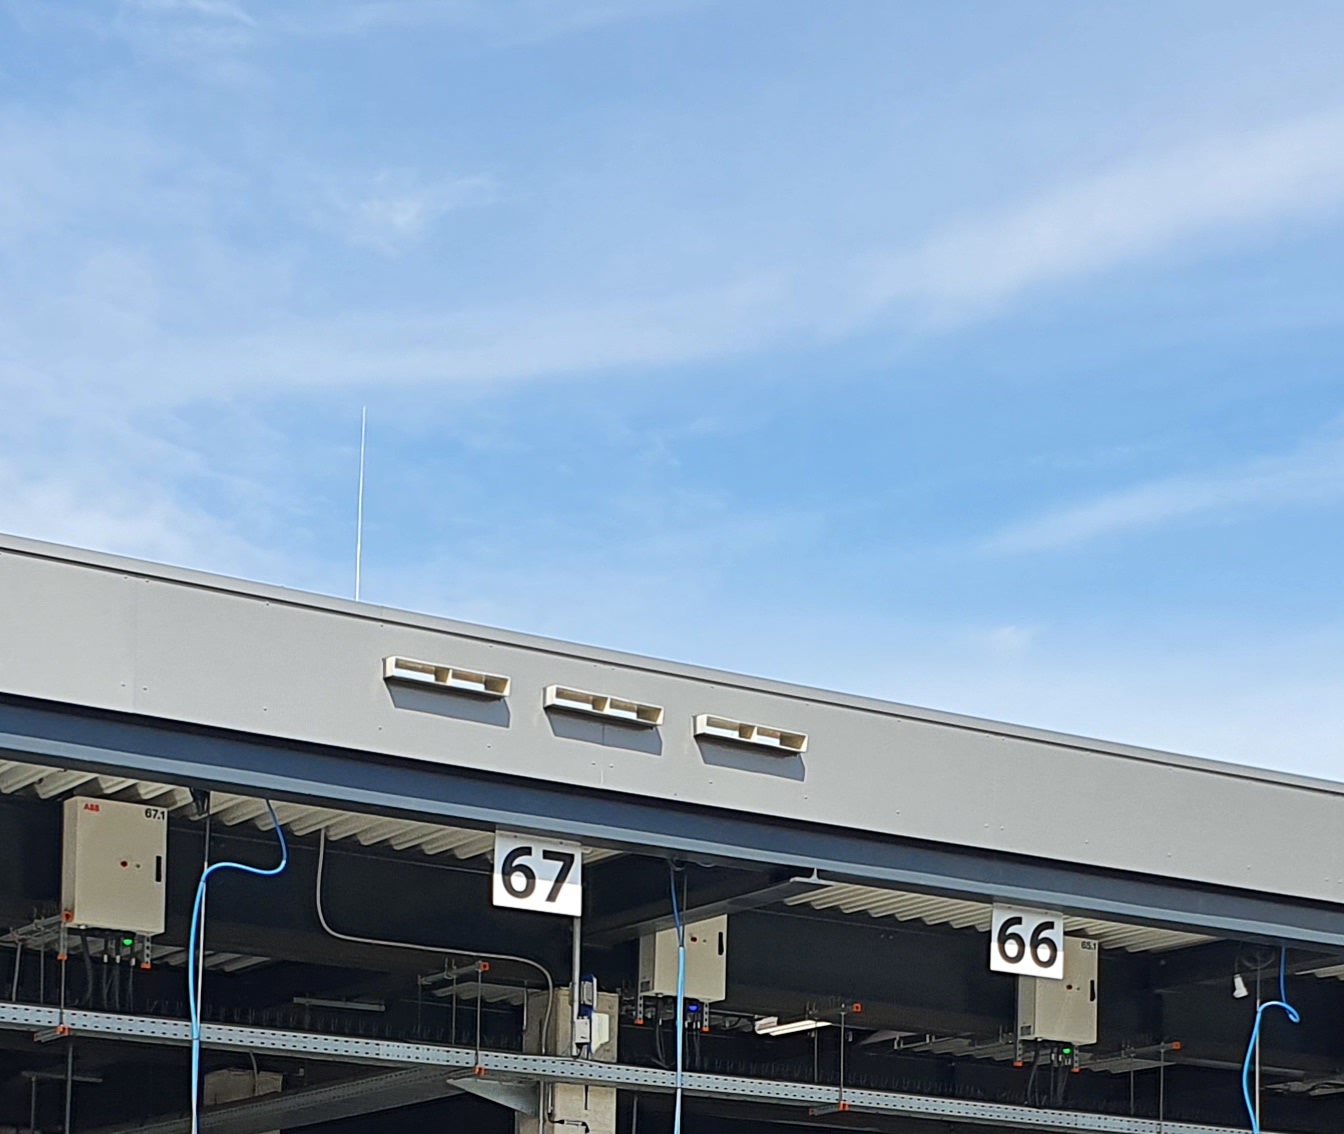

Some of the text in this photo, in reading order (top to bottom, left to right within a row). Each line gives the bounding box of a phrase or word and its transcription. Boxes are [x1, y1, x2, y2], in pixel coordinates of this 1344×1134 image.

[144, 808, 165, 820] 67.1
[501, 846, 575, 903] 67
[998, 916, 1058, 969] 66
